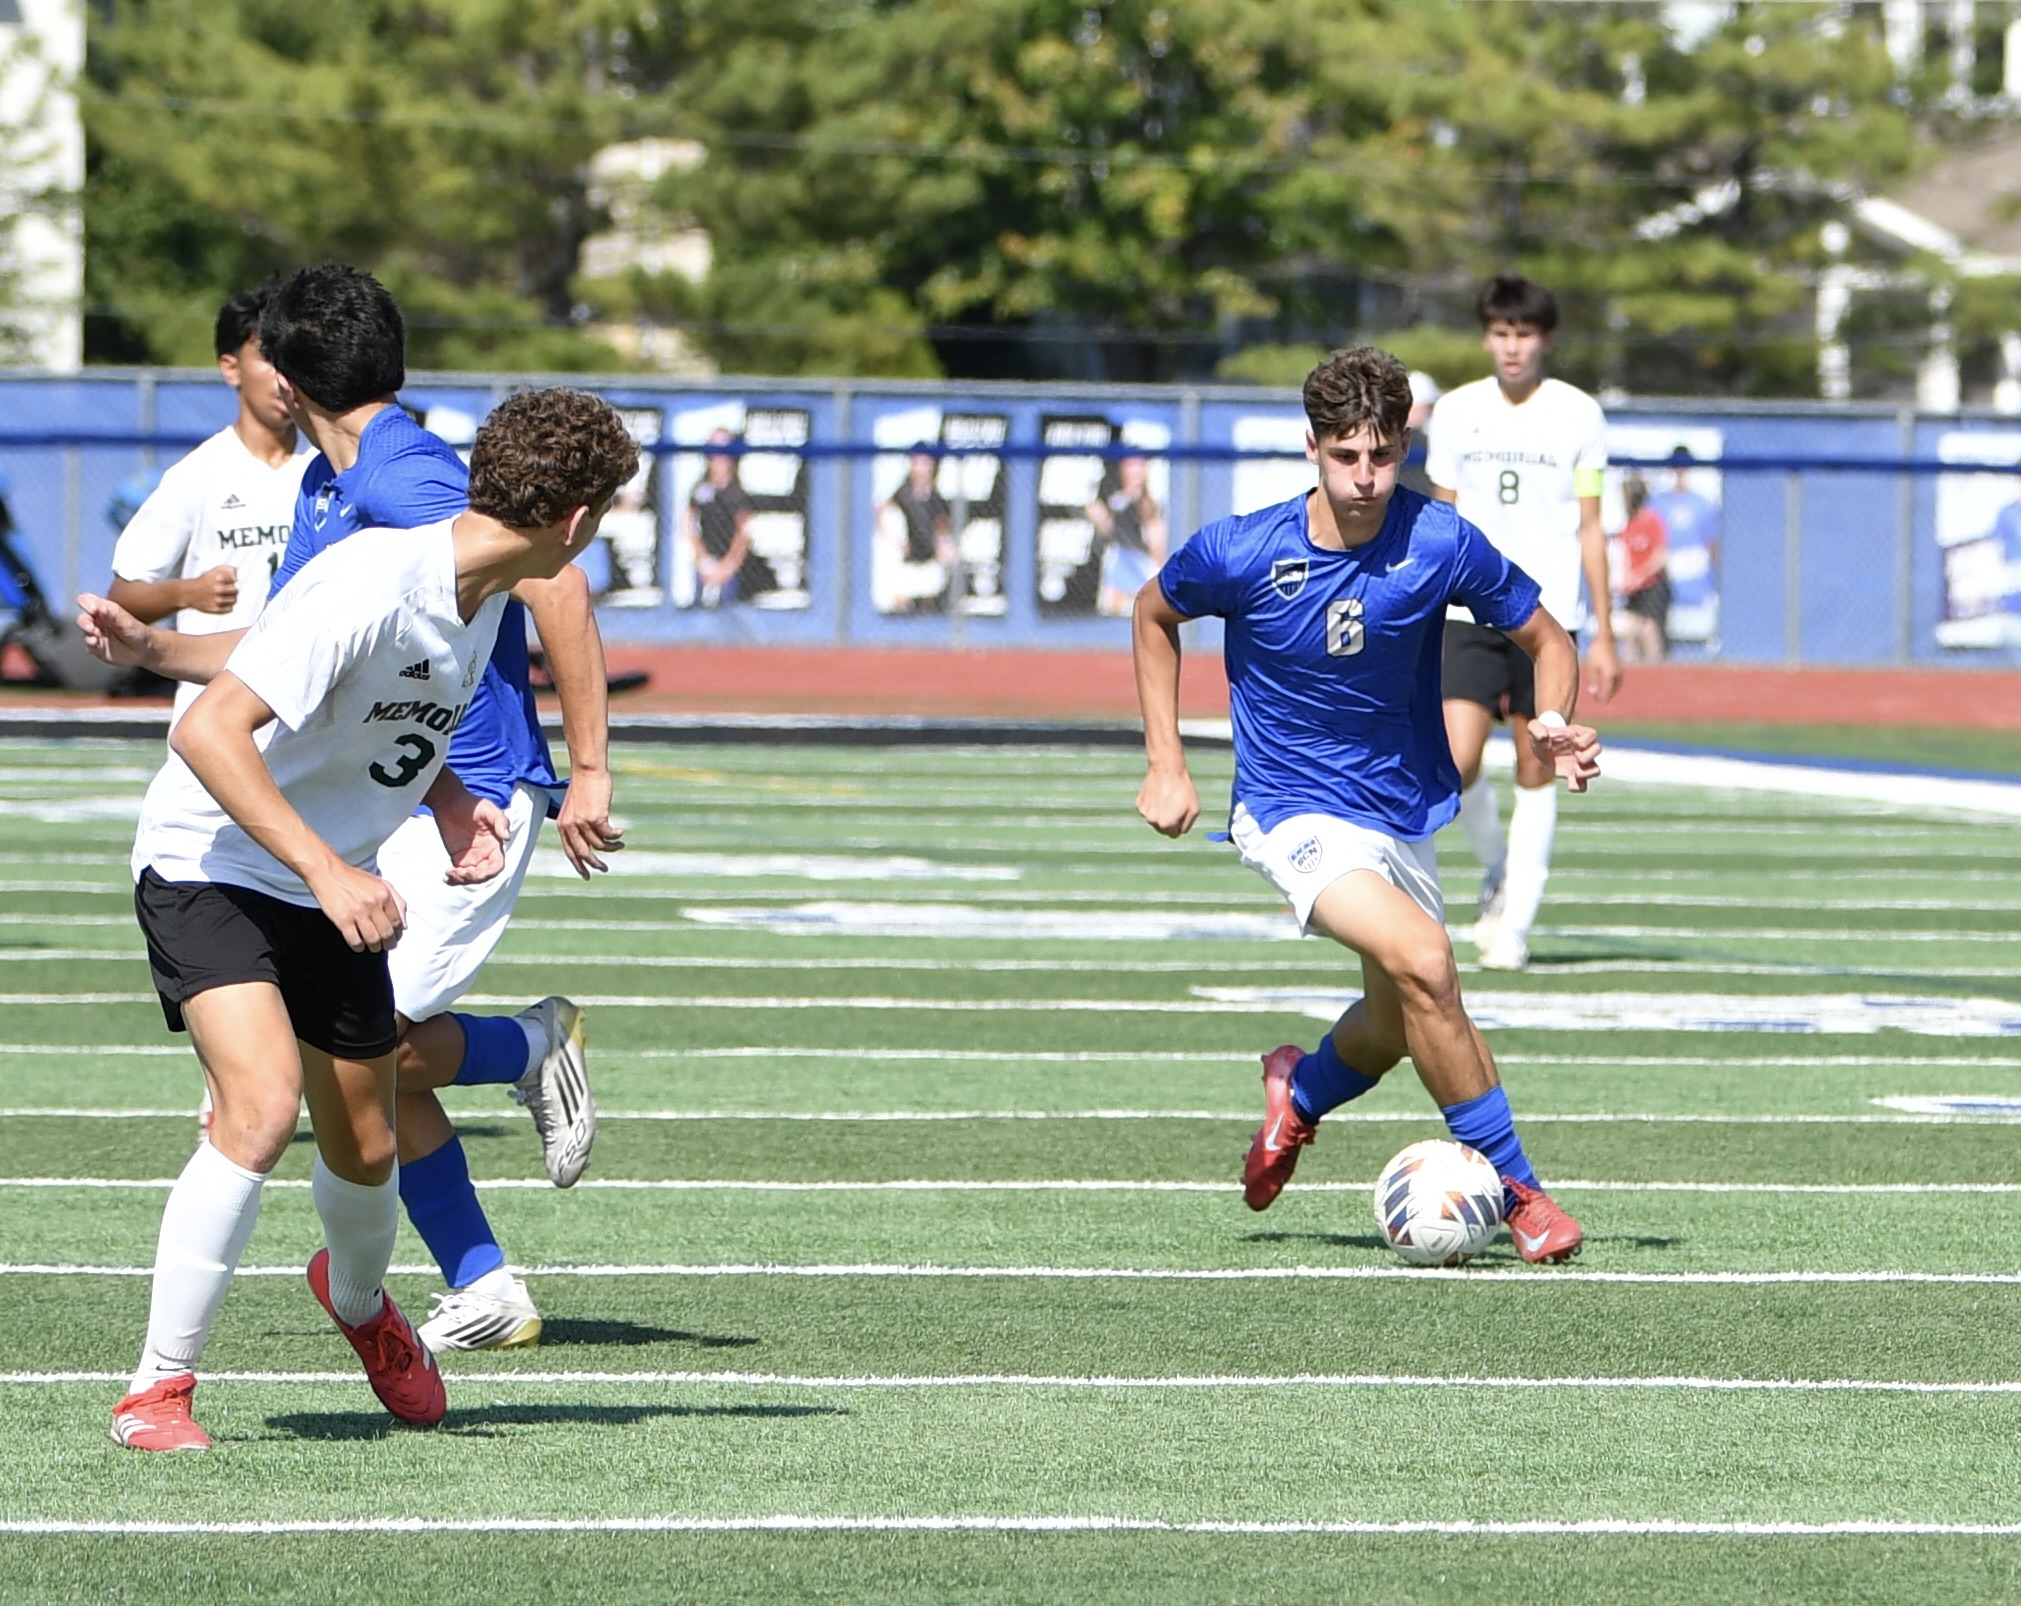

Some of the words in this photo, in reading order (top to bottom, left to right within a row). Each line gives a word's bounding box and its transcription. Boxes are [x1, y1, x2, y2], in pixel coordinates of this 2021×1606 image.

[1499, 470, 1519, 504] 8
[1325, 598, 1366, 658] 6
[369, 734, 436, 788] 3
